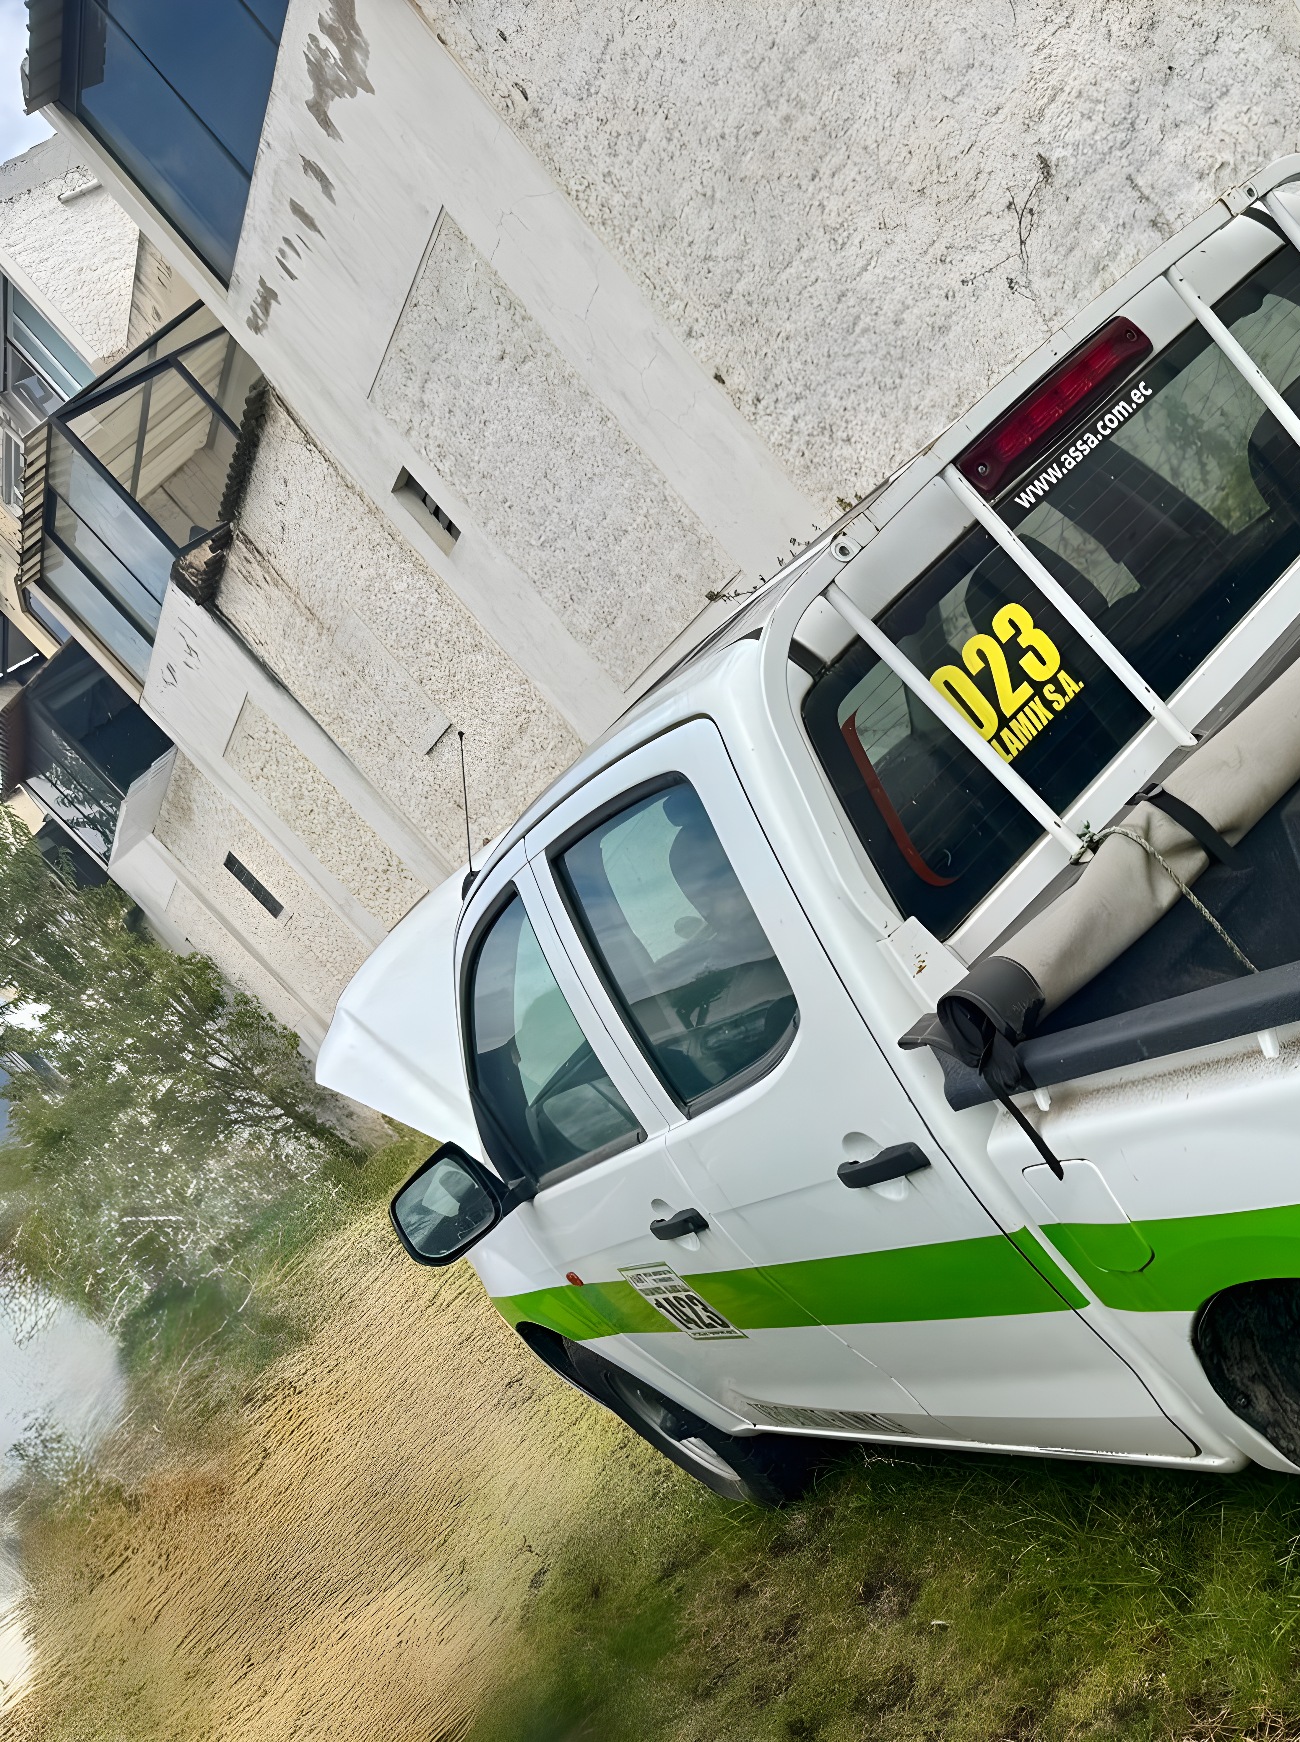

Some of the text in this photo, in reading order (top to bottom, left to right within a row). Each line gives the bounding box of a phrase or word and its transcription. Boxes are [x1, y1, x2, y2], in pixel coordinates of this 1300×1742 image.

[1013, 379, 1153, 509] www.assa.com.ec
[990, 669, 1085, 764] LAMIX S.A.
